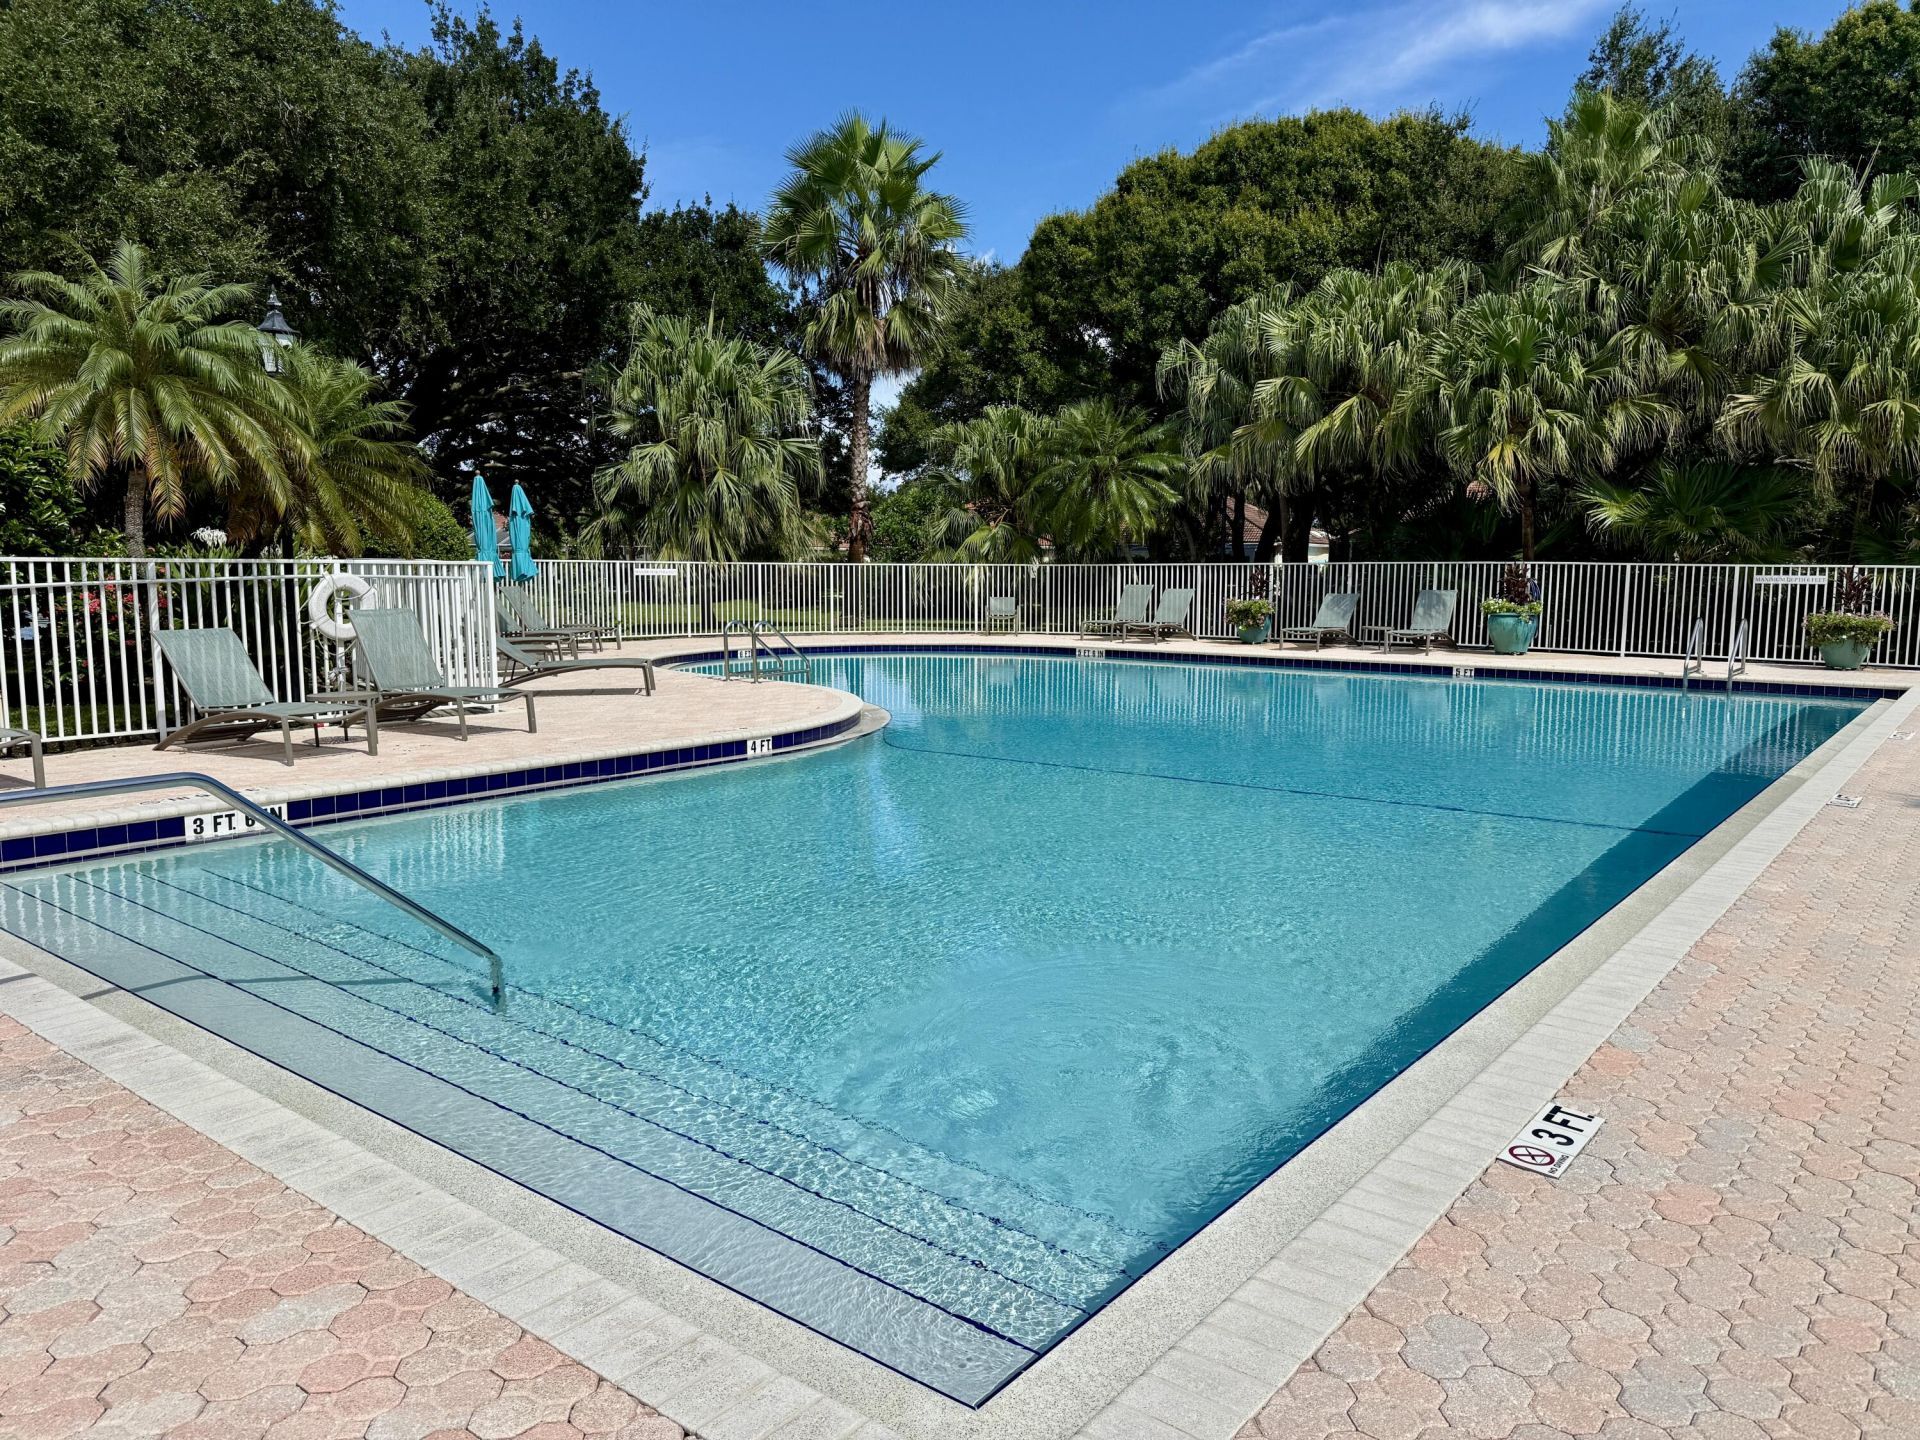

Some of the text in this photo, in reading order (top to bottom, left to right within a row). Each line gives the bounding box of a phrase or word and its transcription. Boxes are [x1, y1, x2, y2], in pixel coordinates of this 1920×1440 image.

[1083, 649, 1090, 657] FT
[1097, 650, 1104, 658] IN
[1463, 668, 1473, 677] FT
[750, 739, 771, 753] 4 FT
[193, 817, 204, 835] 3
[213, 813, 236, 832] FT.
[1531, 1105, 1595, 1147] 3 FT.
